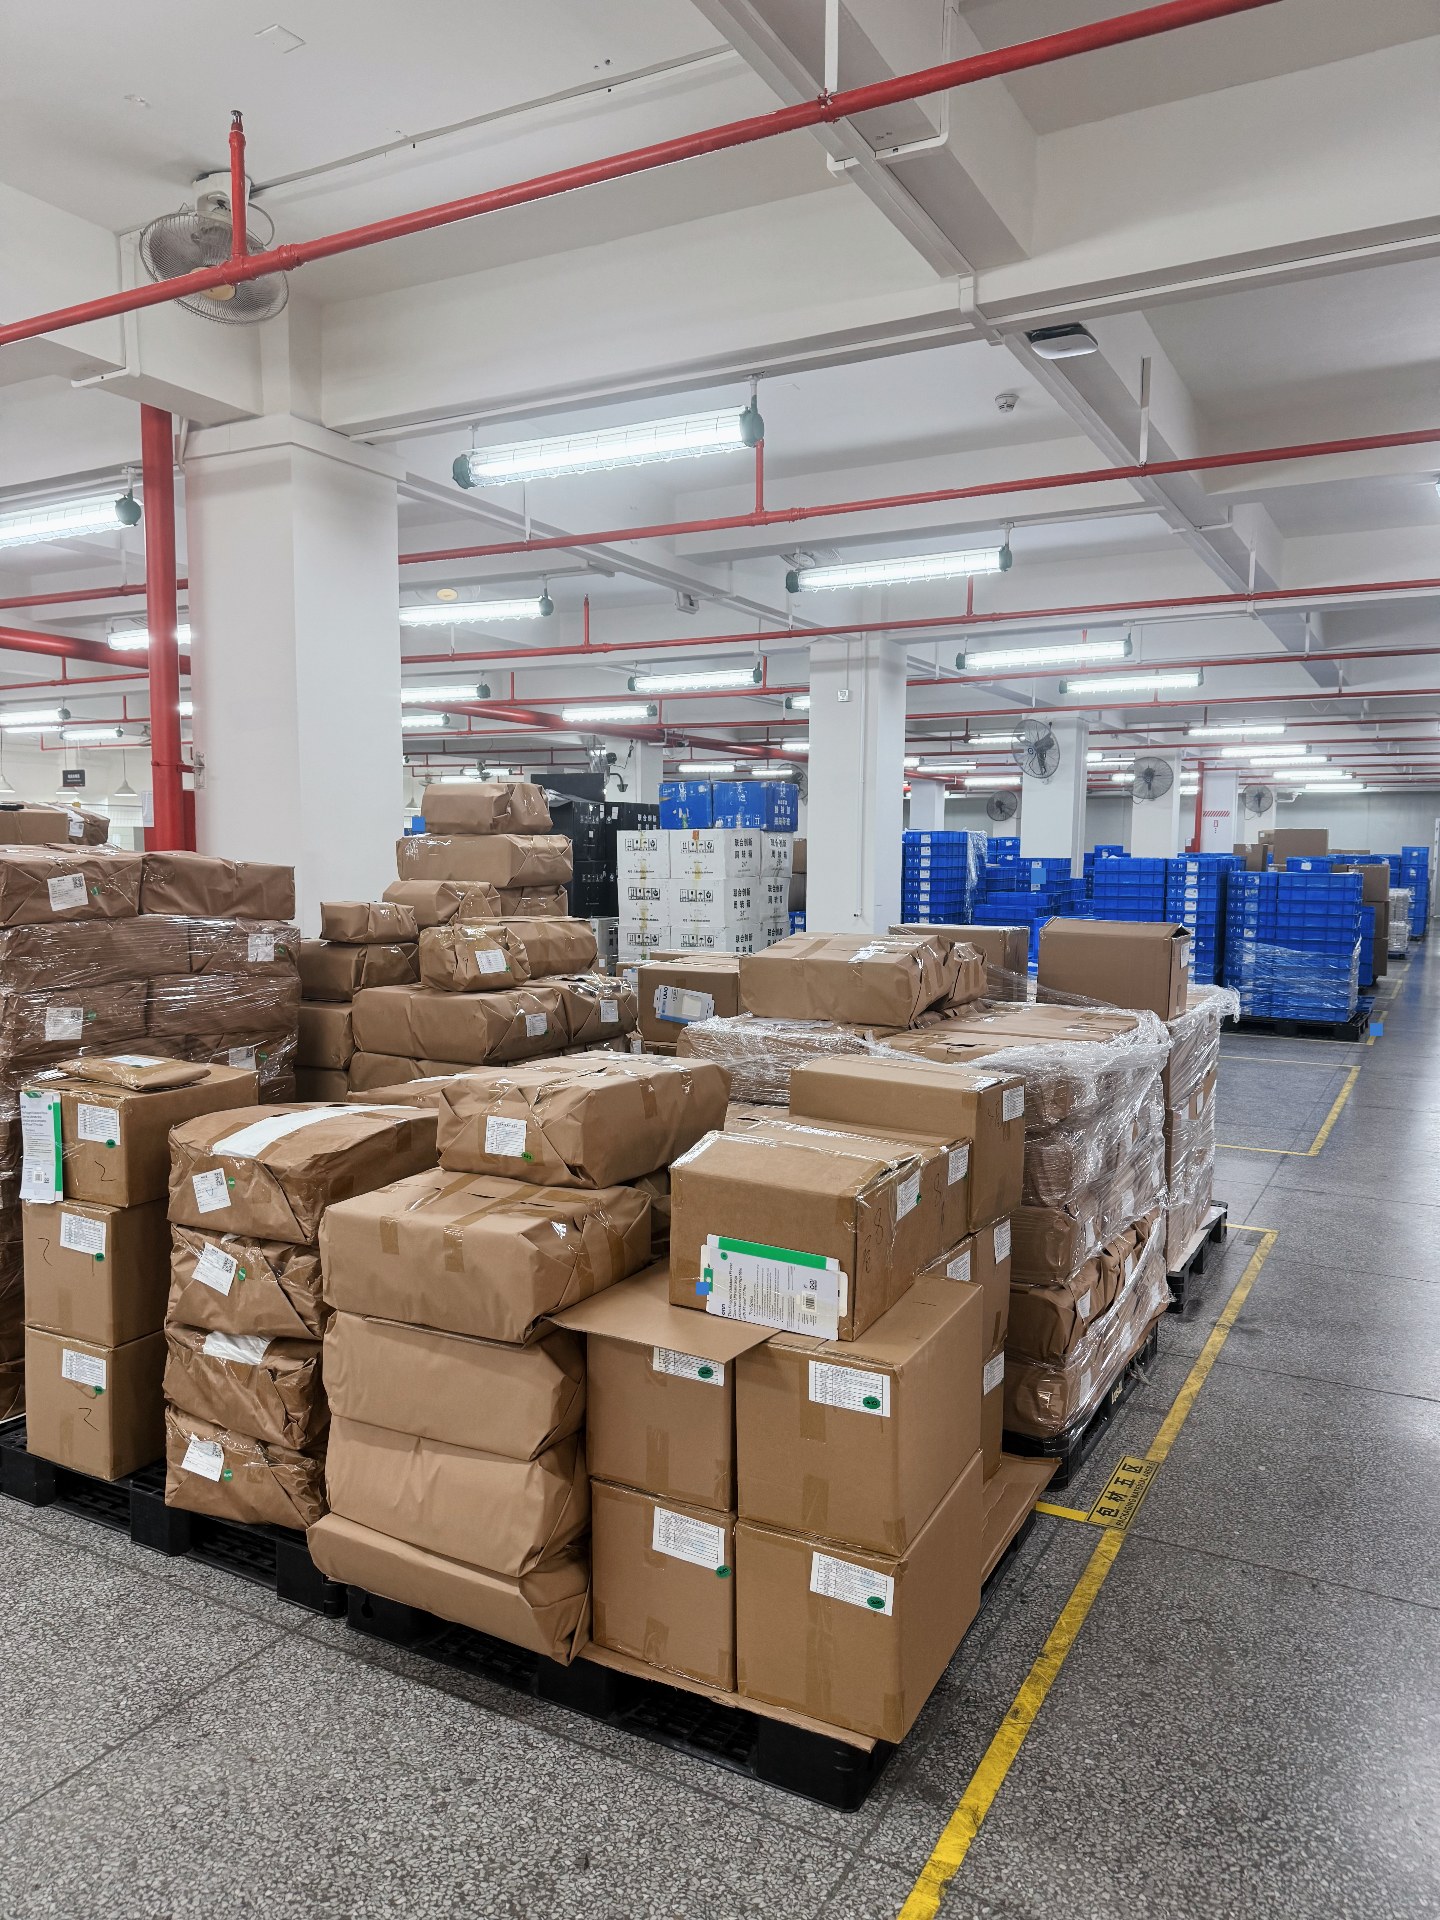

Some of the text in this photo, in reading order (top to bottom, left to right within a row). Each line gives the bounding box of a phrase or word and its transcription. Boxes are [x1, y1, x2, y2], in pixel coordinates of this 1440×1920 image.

[734, 837, 753, 847] 联合创新
[733, 888, 751, 897] 联合创新
[735, 933, 753, 943] 联合创新
[1096, 1462, 1143, 1518] 包材五区
[1116, 1498, 1136, 1526] PACKAGING
